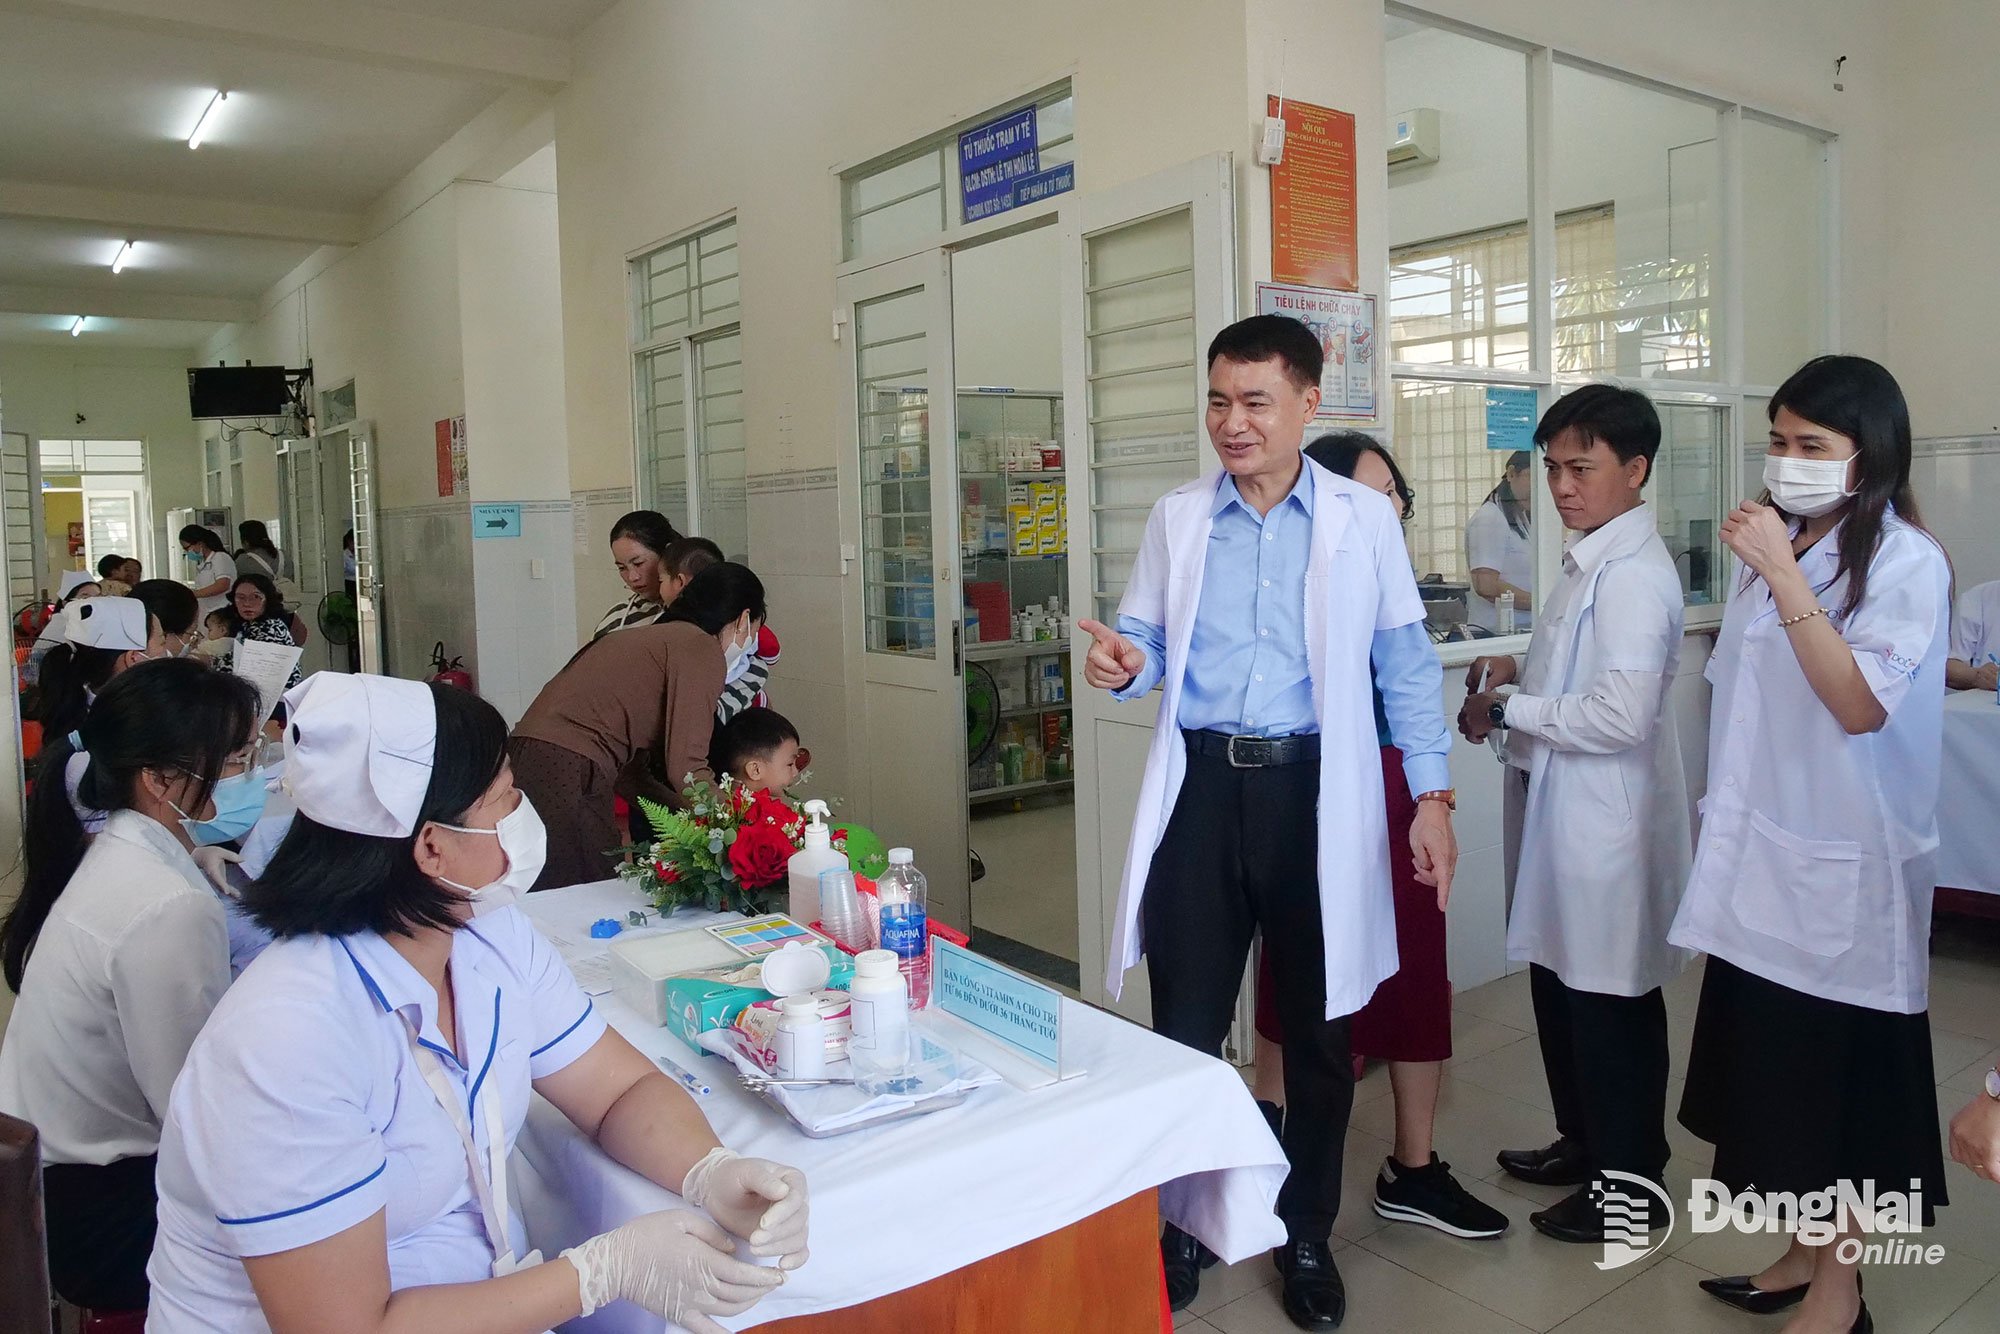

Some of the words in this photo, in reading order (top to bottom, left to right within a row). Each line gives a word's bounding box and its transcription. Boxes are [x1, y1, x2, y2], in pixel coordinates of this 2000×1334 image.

[973, 129, 995, 157] THUỐC
[996, 127, 1014, 150] TRẠM
[1015, 124, 1020, 141] Y
[1296, 296, 1316, 312] LỆNH
[884, 928, 920, 940] AQUAFINA
[944, 967, 958, 982] BÀN
[959, 974, 980, 993] UỐNG
[981, 983, 1014, 1007] VITAMIN
[1015, 1001, 1021, 1011] A
[1023, 1002, 1041, 1018] CHO
[944, 982, 955, 995] TỪ
[963, 988, 978, 1005] ĐẾN
[980, 998, 998, 1016] DƯỚI
[1000, 1007, 1008, 1019] 36
[1009, 1011, 1037, 1033] THÁNG
[1038, 1023, 1056, 1041] TUỔ
